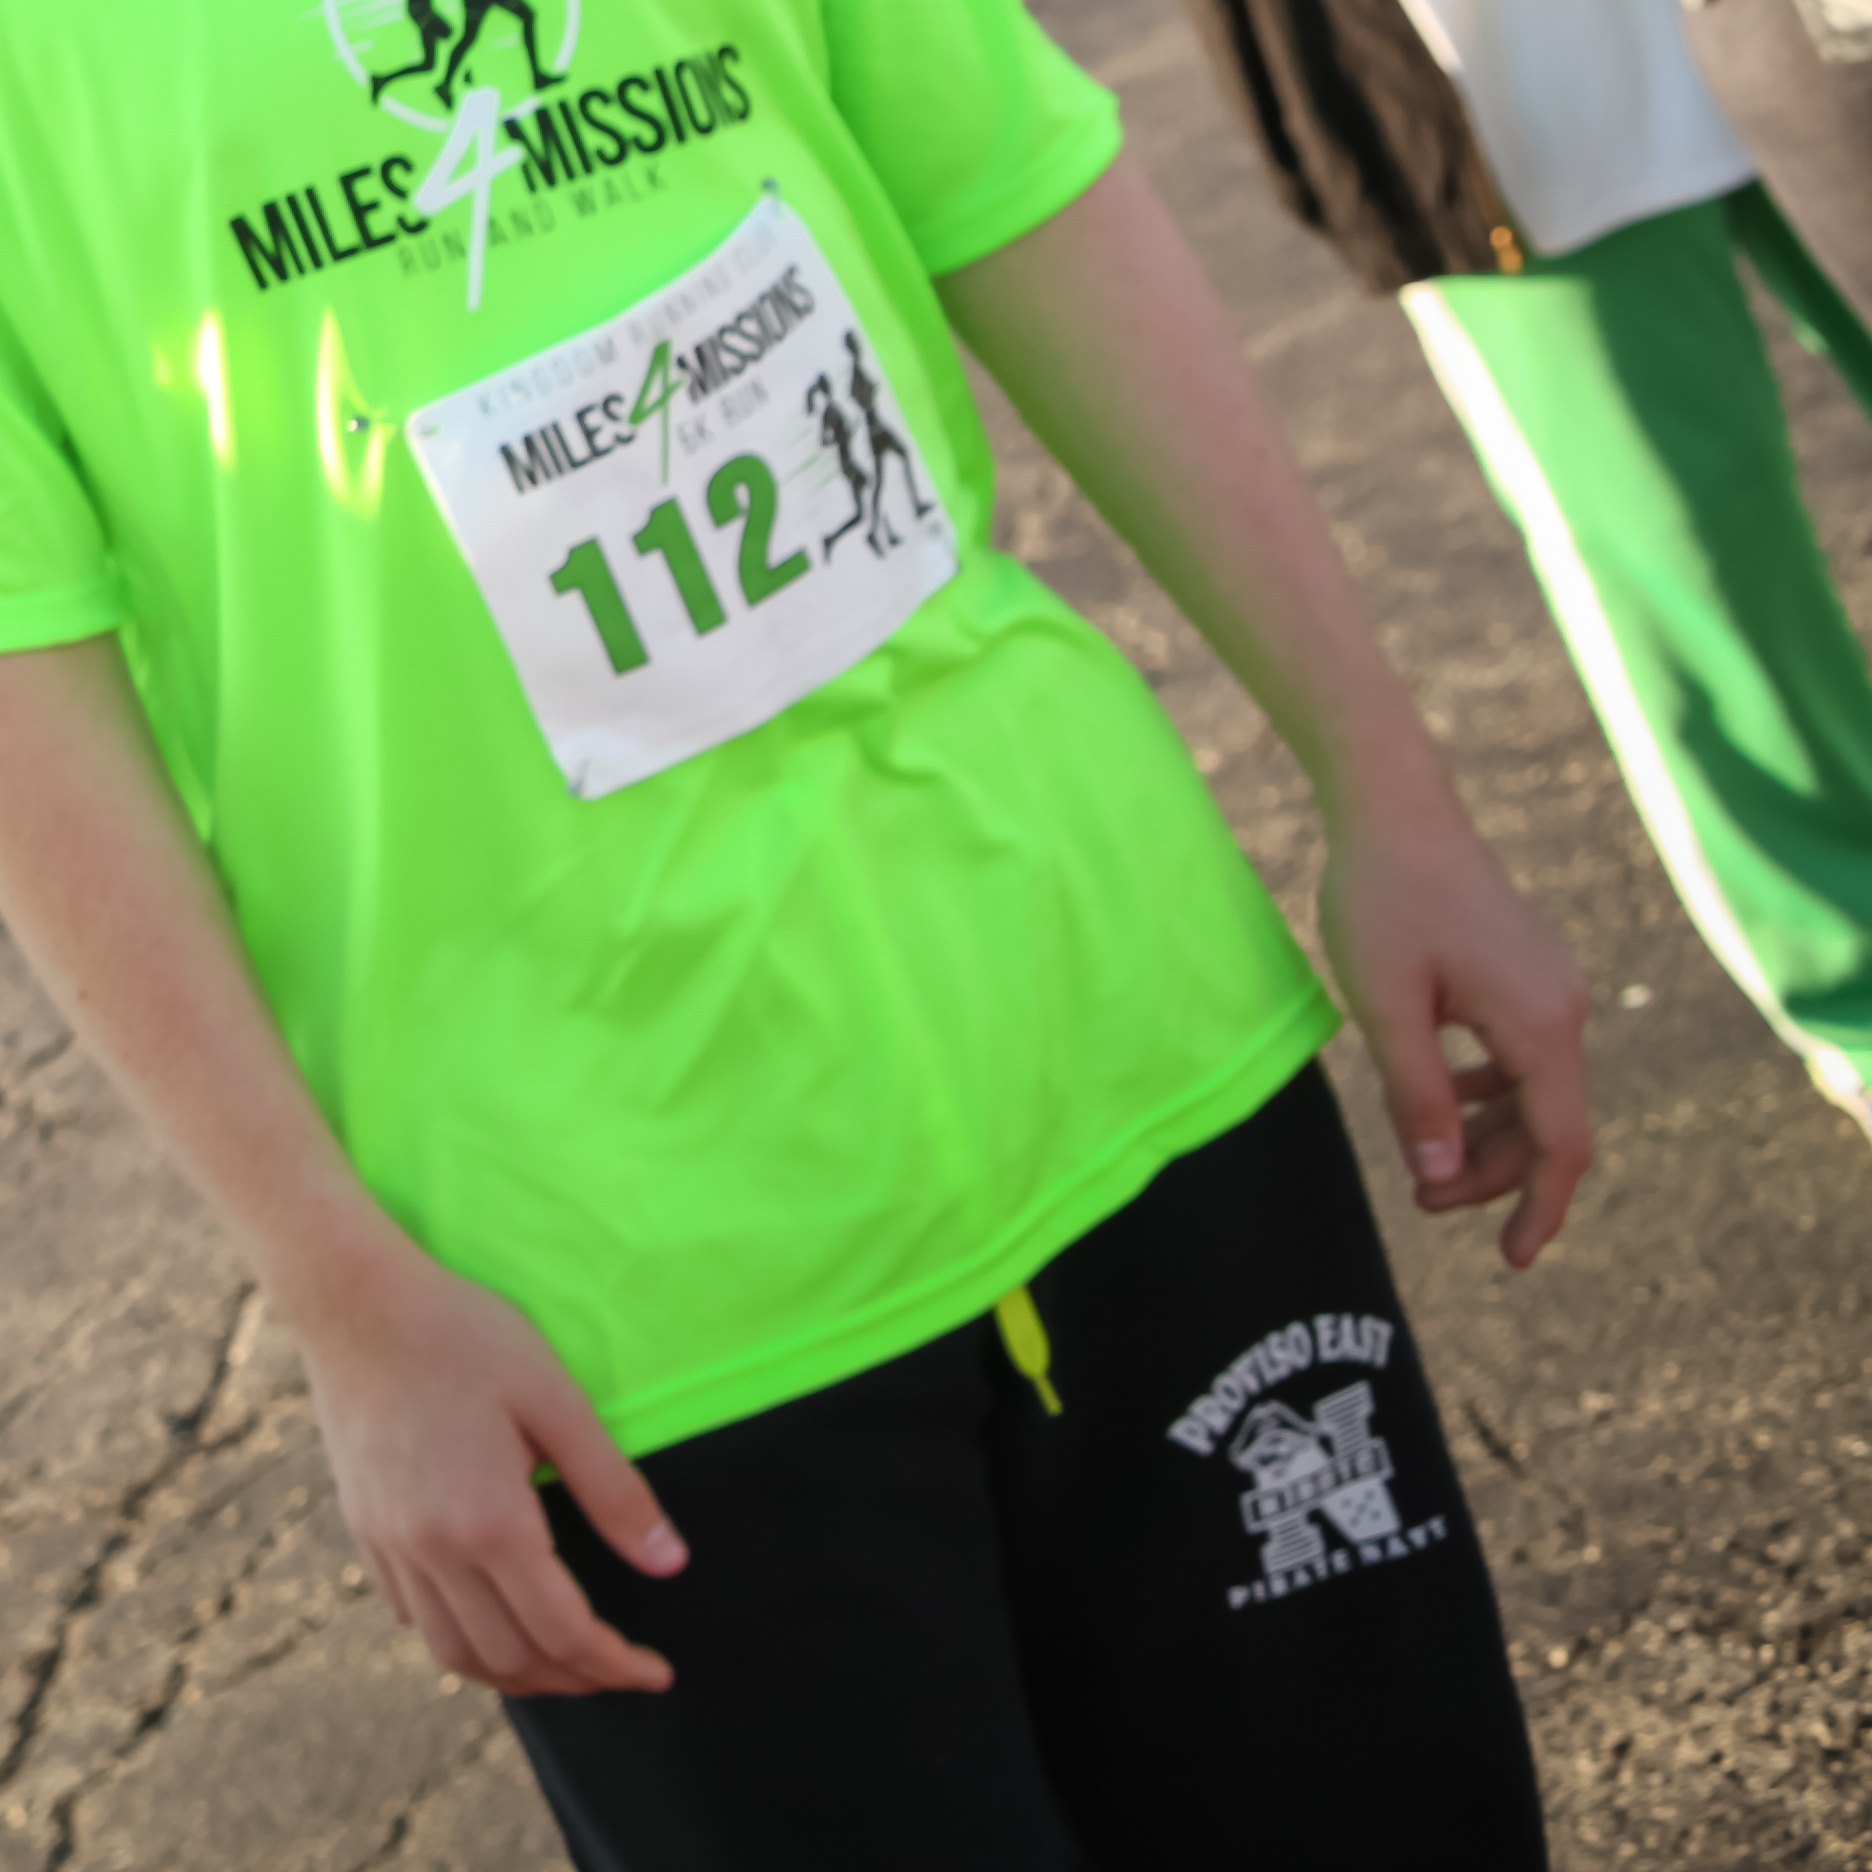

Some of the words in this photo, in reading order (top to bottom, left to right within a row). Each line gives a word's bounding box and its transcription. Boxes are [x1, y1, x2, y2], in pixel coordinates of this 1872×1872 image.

[229, 155, 430, 292] MILES
[503, 44, 751, 195] MISSIONS
[397, 236, 469, 279] RUN
[485, 201, 556, 249] AND
[568, 167, 669, 219] WALK
[499, 392, 636, 496] MILES
[675, 262, 816, 406] MISSIONS
[549, 452, 811, 677] 112
[1166, 1320, 1313, 1457] PROVISO
[1314, 1312, 1393, 1368] EAST
